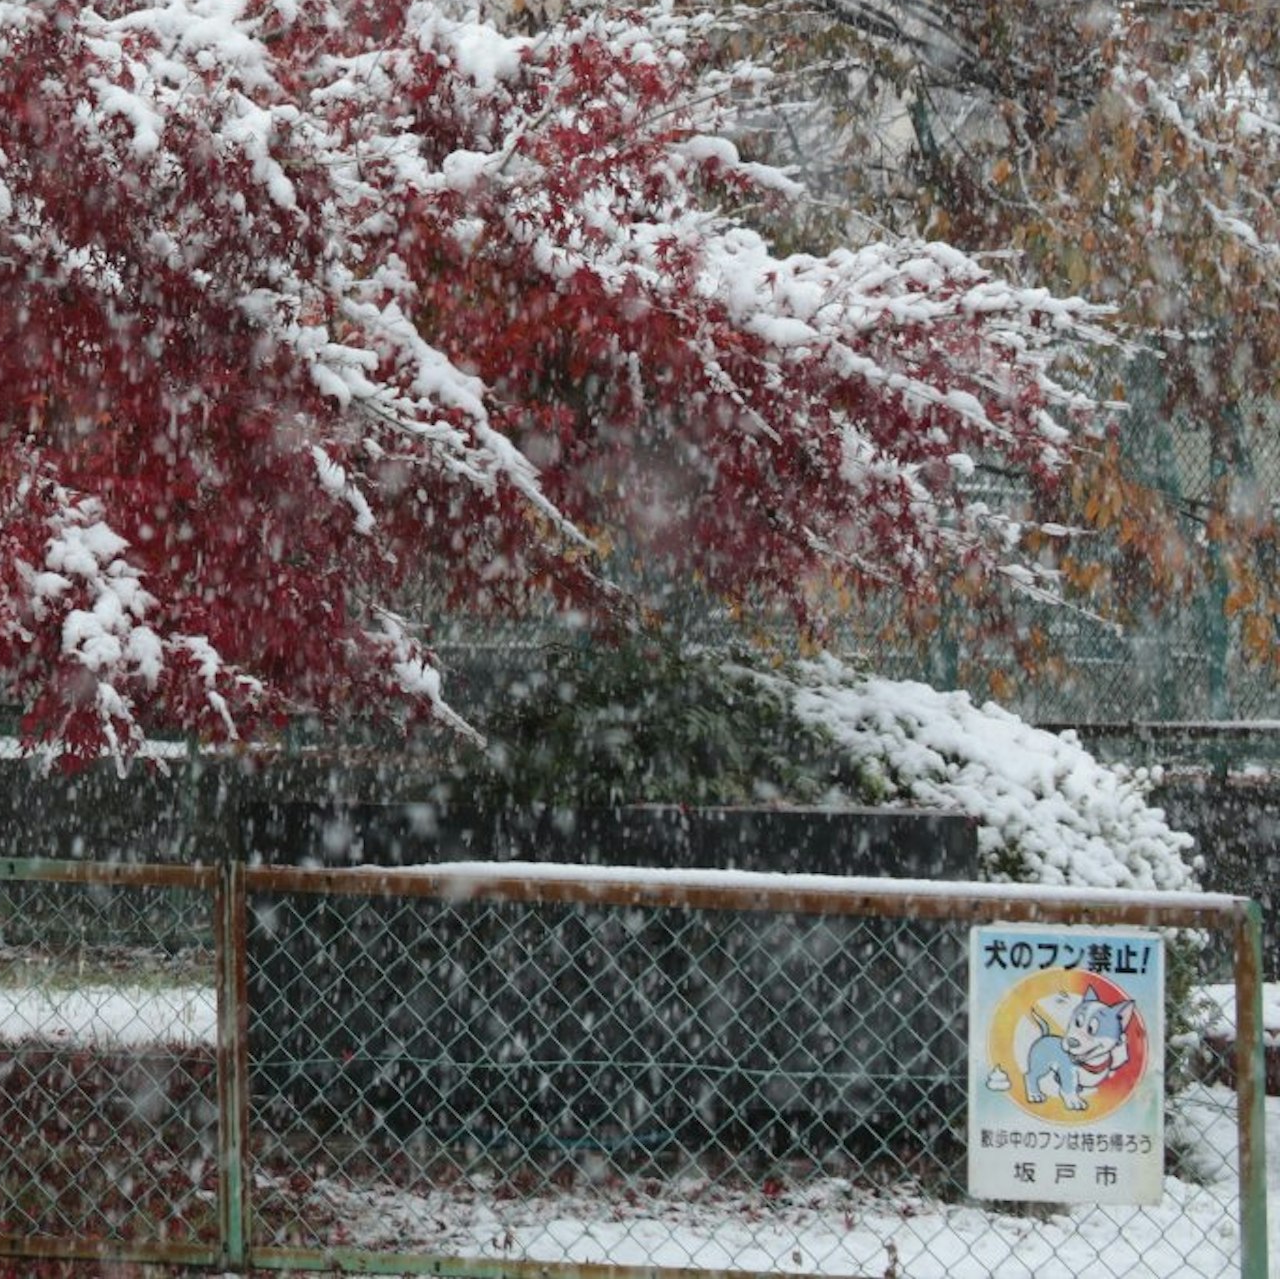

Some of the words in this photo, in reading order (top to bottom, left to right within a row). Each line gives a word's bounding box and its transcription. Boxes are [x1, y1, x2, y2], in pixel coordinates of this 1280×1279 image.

[984, 939, 1151, 974] 犬のフン禁止!
[981, 1128, 1152, 1154] 散歩中のフンは持ち帰ろう
[1013, 1162, 1117, 1186] 坂戸市
